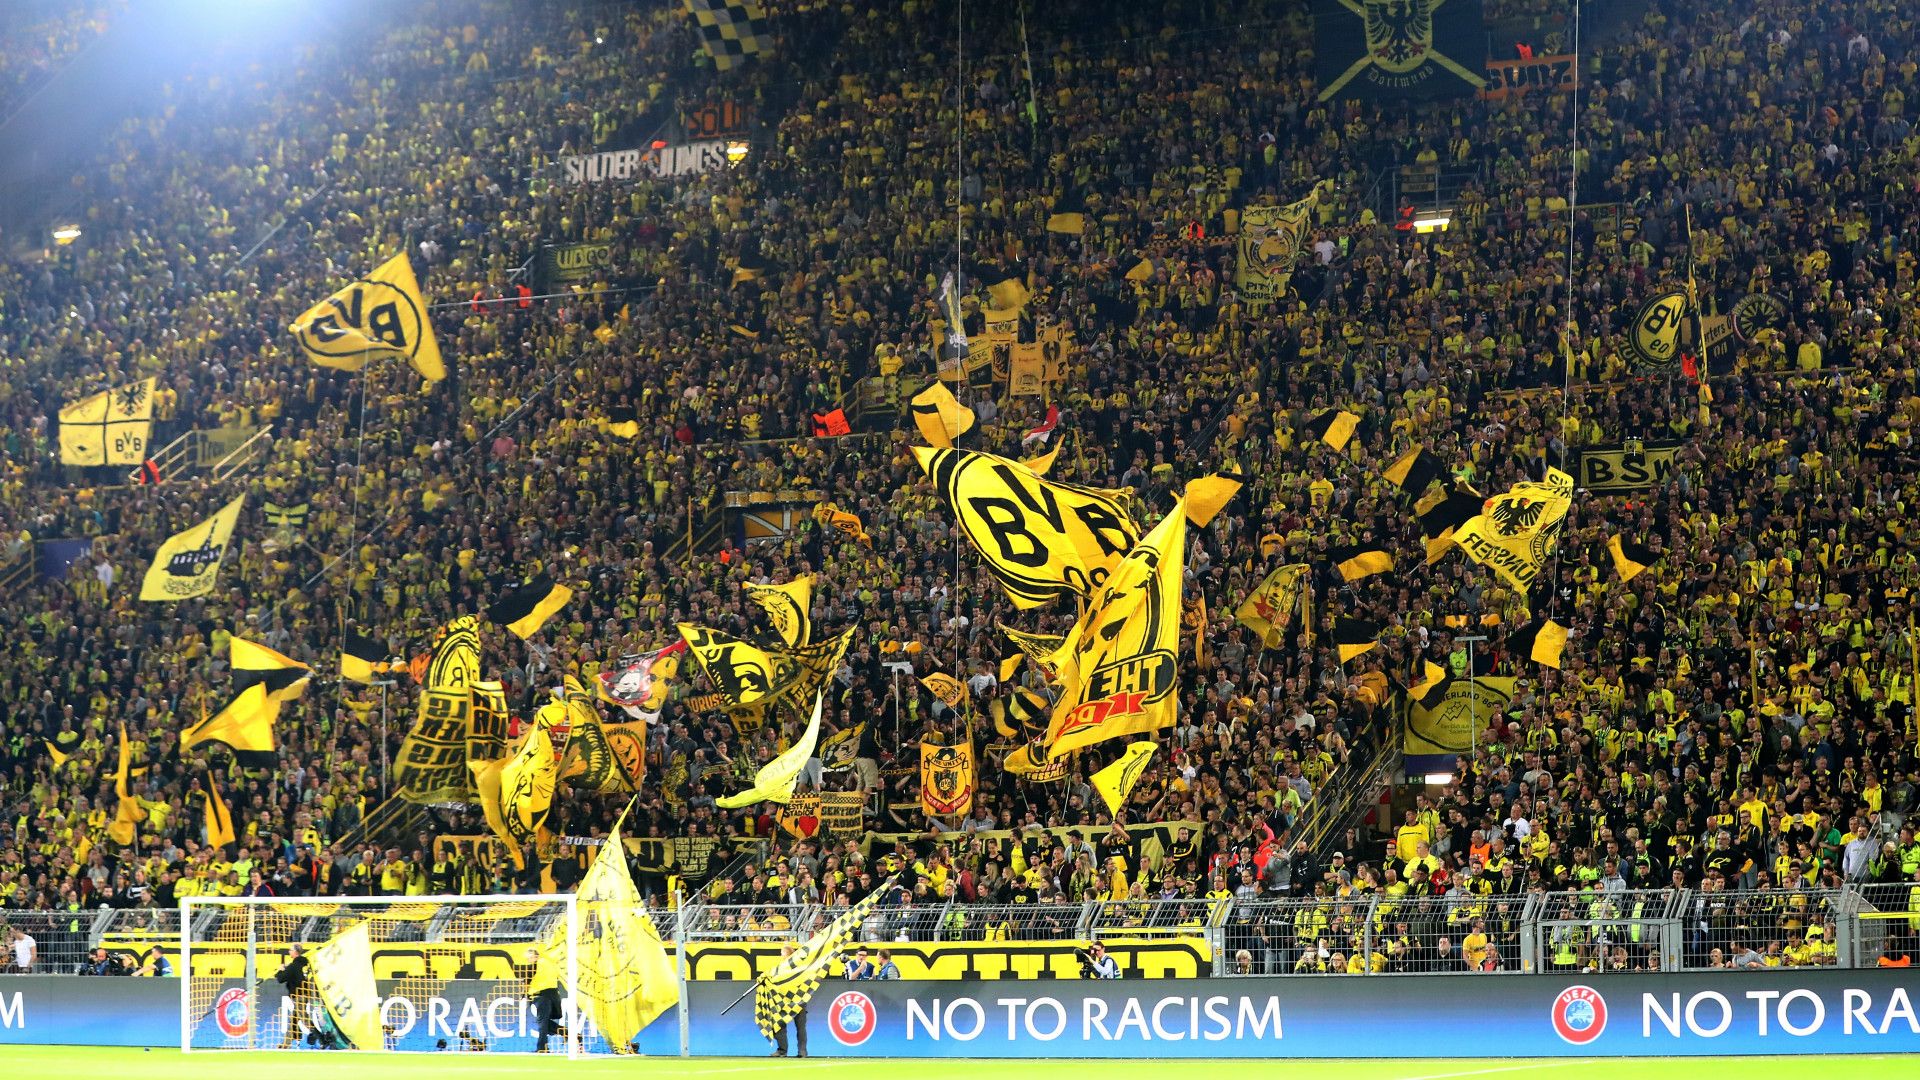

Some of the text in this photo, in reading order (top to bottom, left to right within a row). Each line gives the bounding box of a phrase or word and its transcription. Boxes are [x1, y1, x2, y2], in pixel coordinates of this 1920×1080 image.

[1366, 66, 1434, 89] Dortmund
[115, 431, 142, 452] BVB
[967, 464, 1137, 568] BVB
[837, 996, 867, 1008] UEFA
[1562, 988, 1596, 1003] UEFA
[906, 995, 1283, 1041] NO TO RACISM
[1642, 990, 1733, 1038] NO
[1745, 988, 1826, 1036] TO
